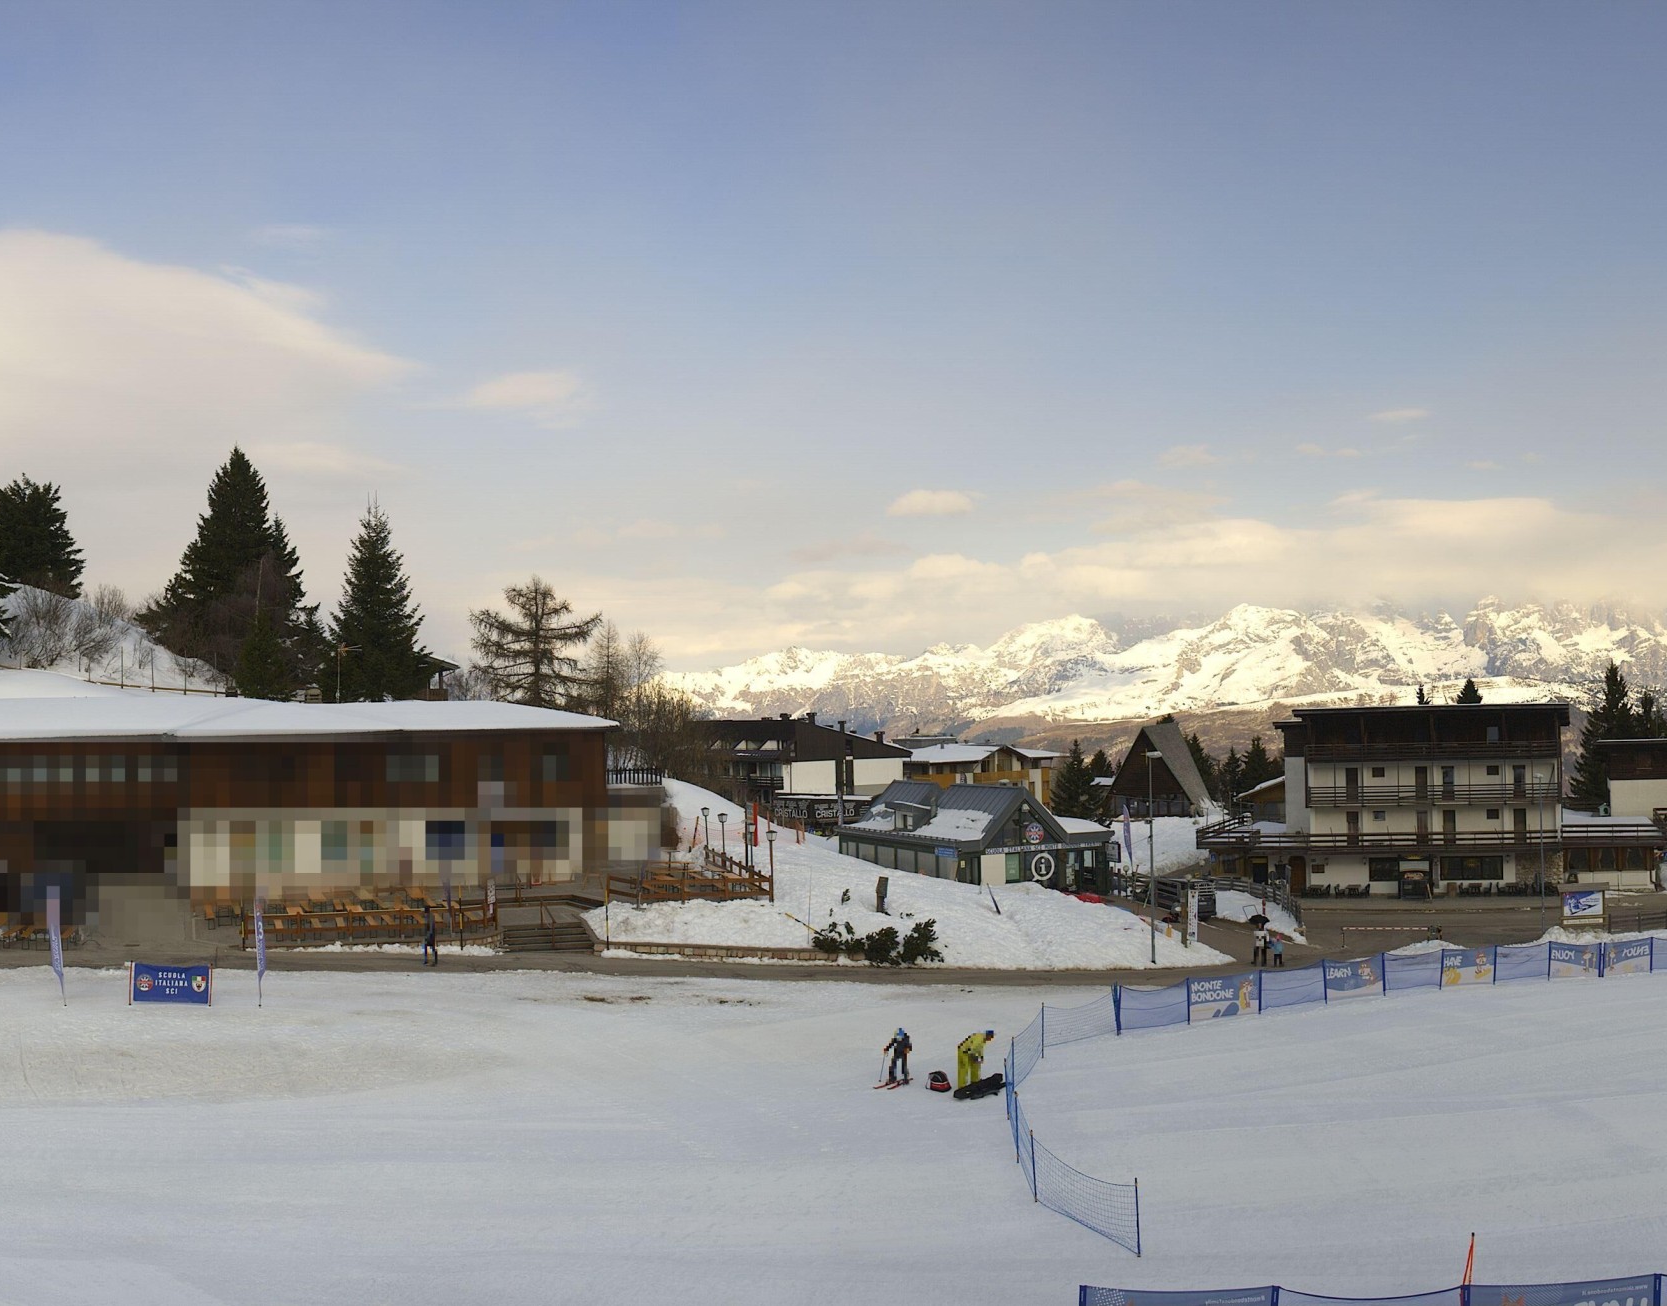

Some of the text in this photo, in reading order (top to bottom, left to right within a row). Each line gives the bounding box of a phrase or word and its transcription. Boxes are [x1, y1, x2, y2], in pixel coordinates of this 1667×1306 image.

[1551, 950, 1575, 960] ENJOY
[1443, 956, 1463, 967] HAVE
[158, 971, 185, 979] SCUOLA
[1326, 966, 1352, 979] LEARN
[1190, 980, 1223, 992] MONTE
[1190, 988, 1234, 1002] BONDONE
